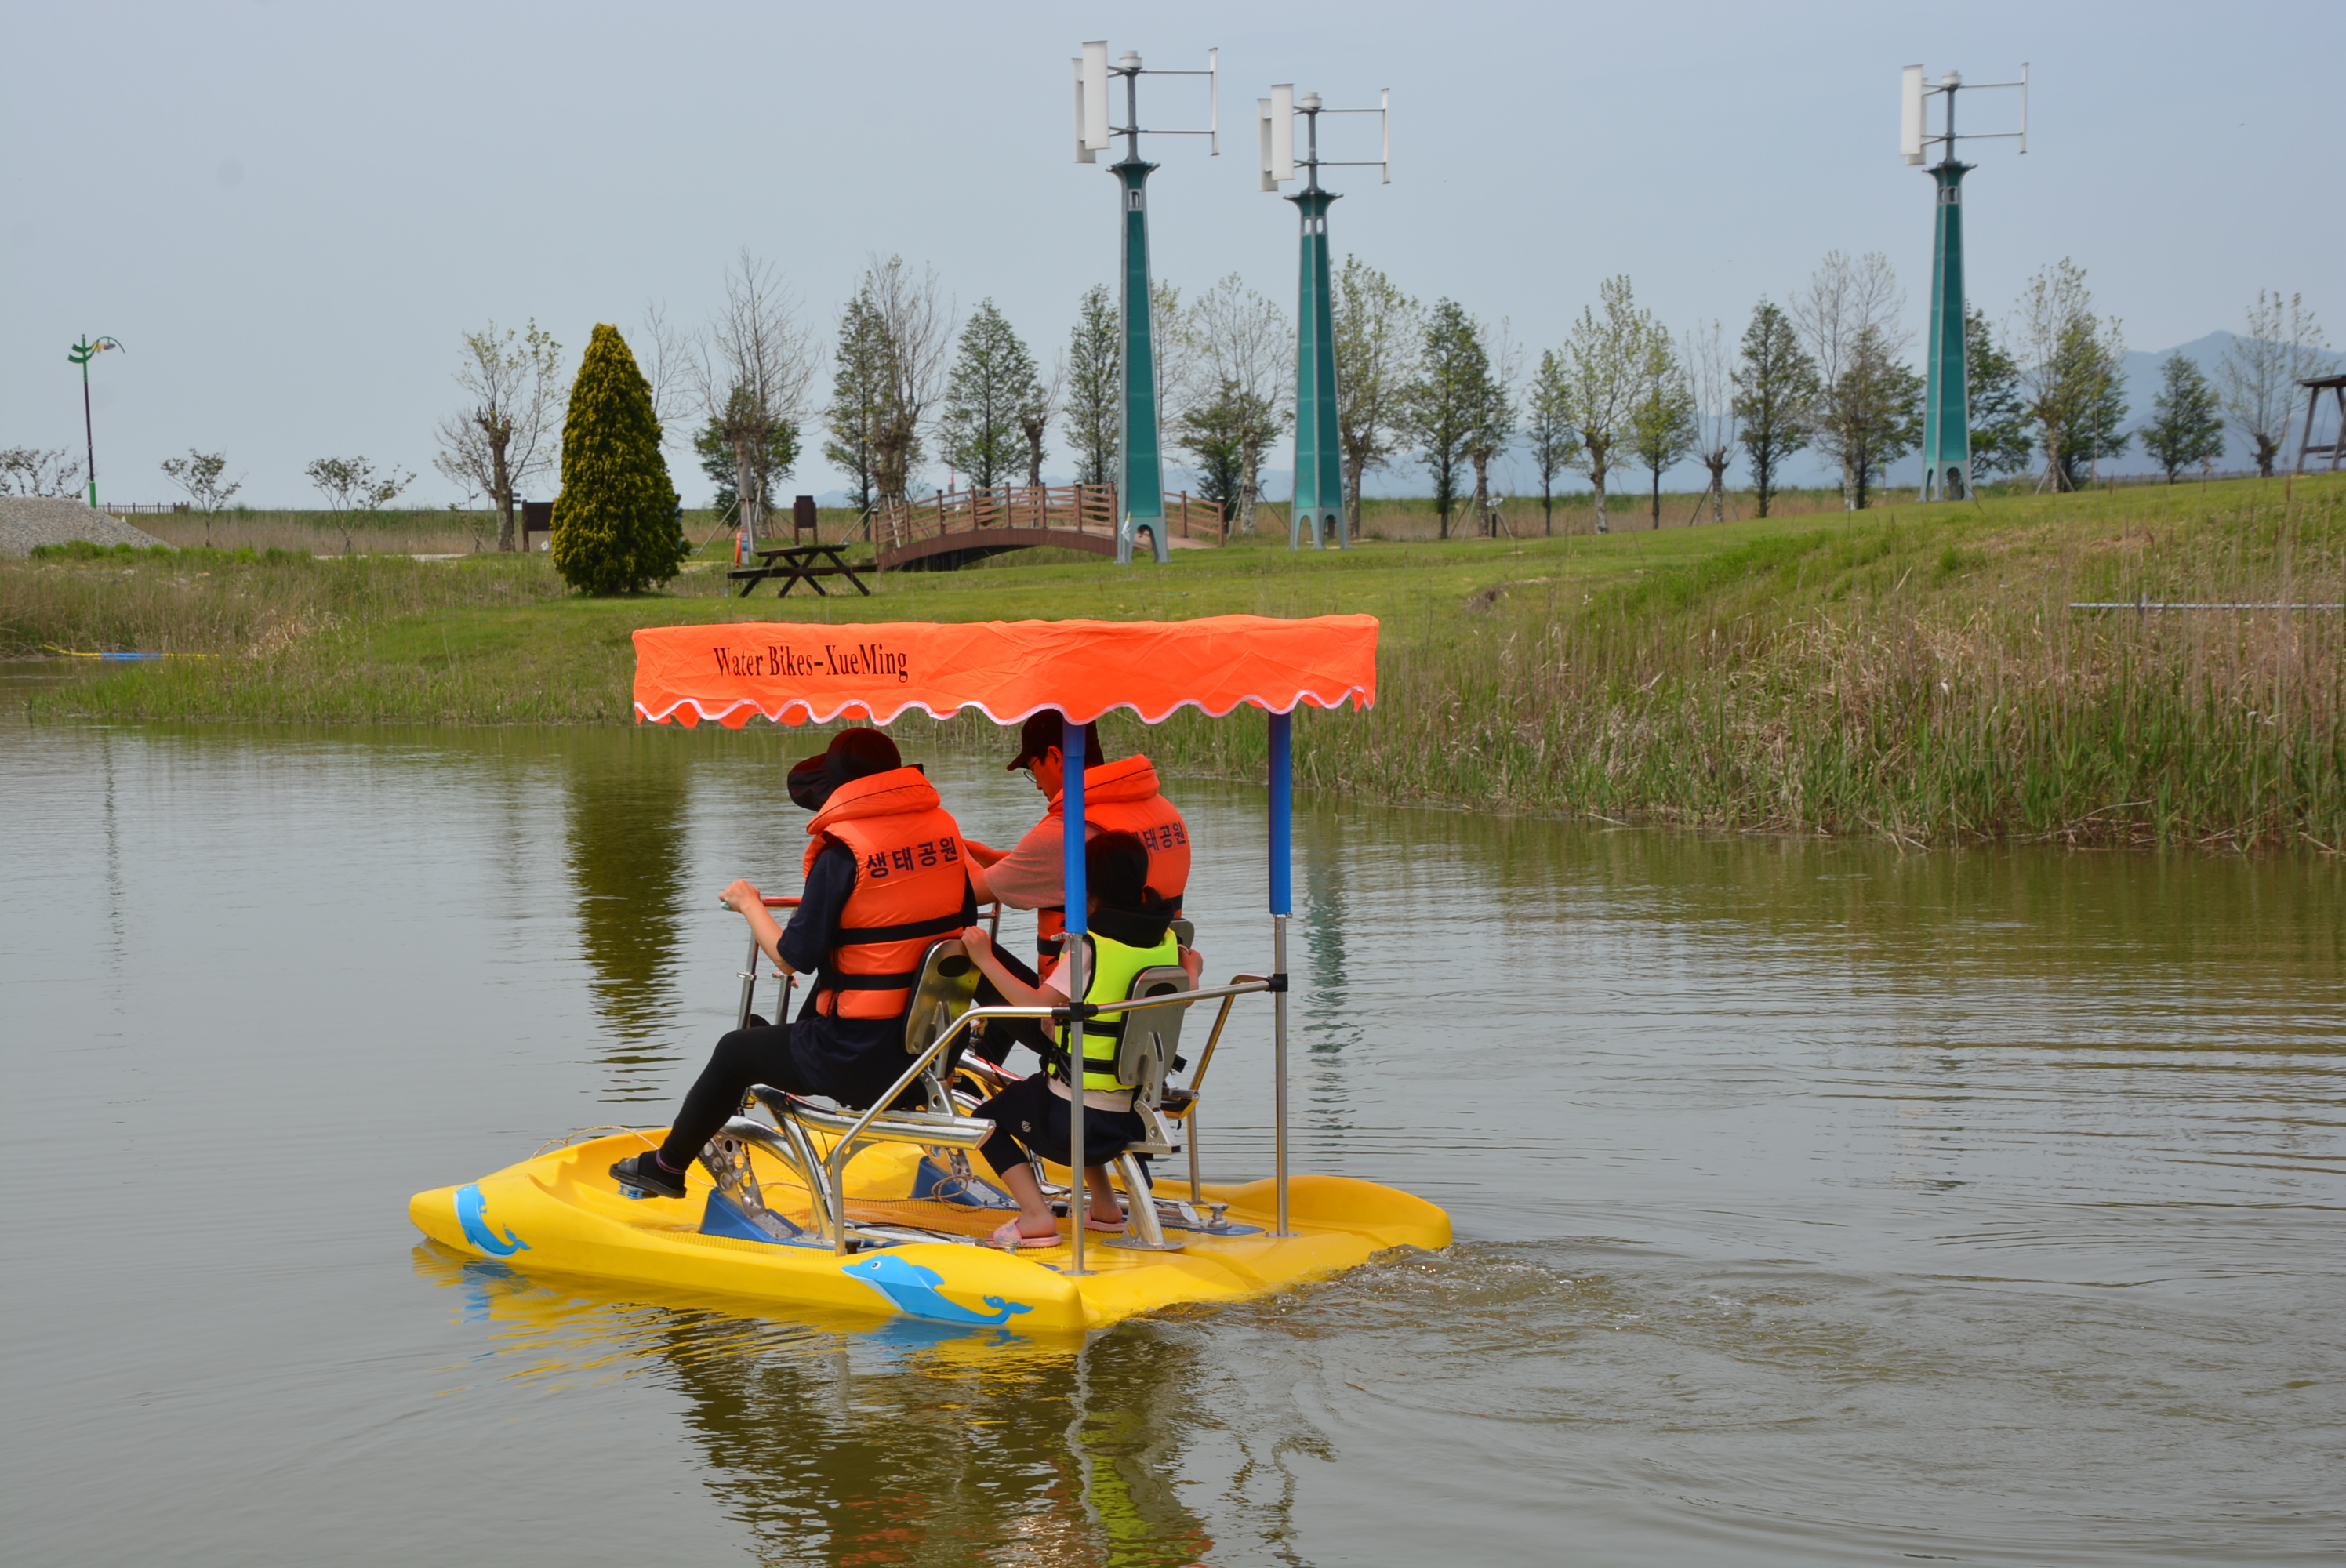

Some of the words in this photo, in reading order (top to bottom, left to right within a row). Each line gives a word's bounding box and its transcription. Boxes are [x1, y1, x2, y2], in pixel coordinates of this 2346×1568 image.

[713, 647, 763, 677] Water
[768, 644, 909, 683] Bikes-XueMing
[1131, 821, 1186, 851] 태공원
[866, 836, 958, 878] 생태공원
